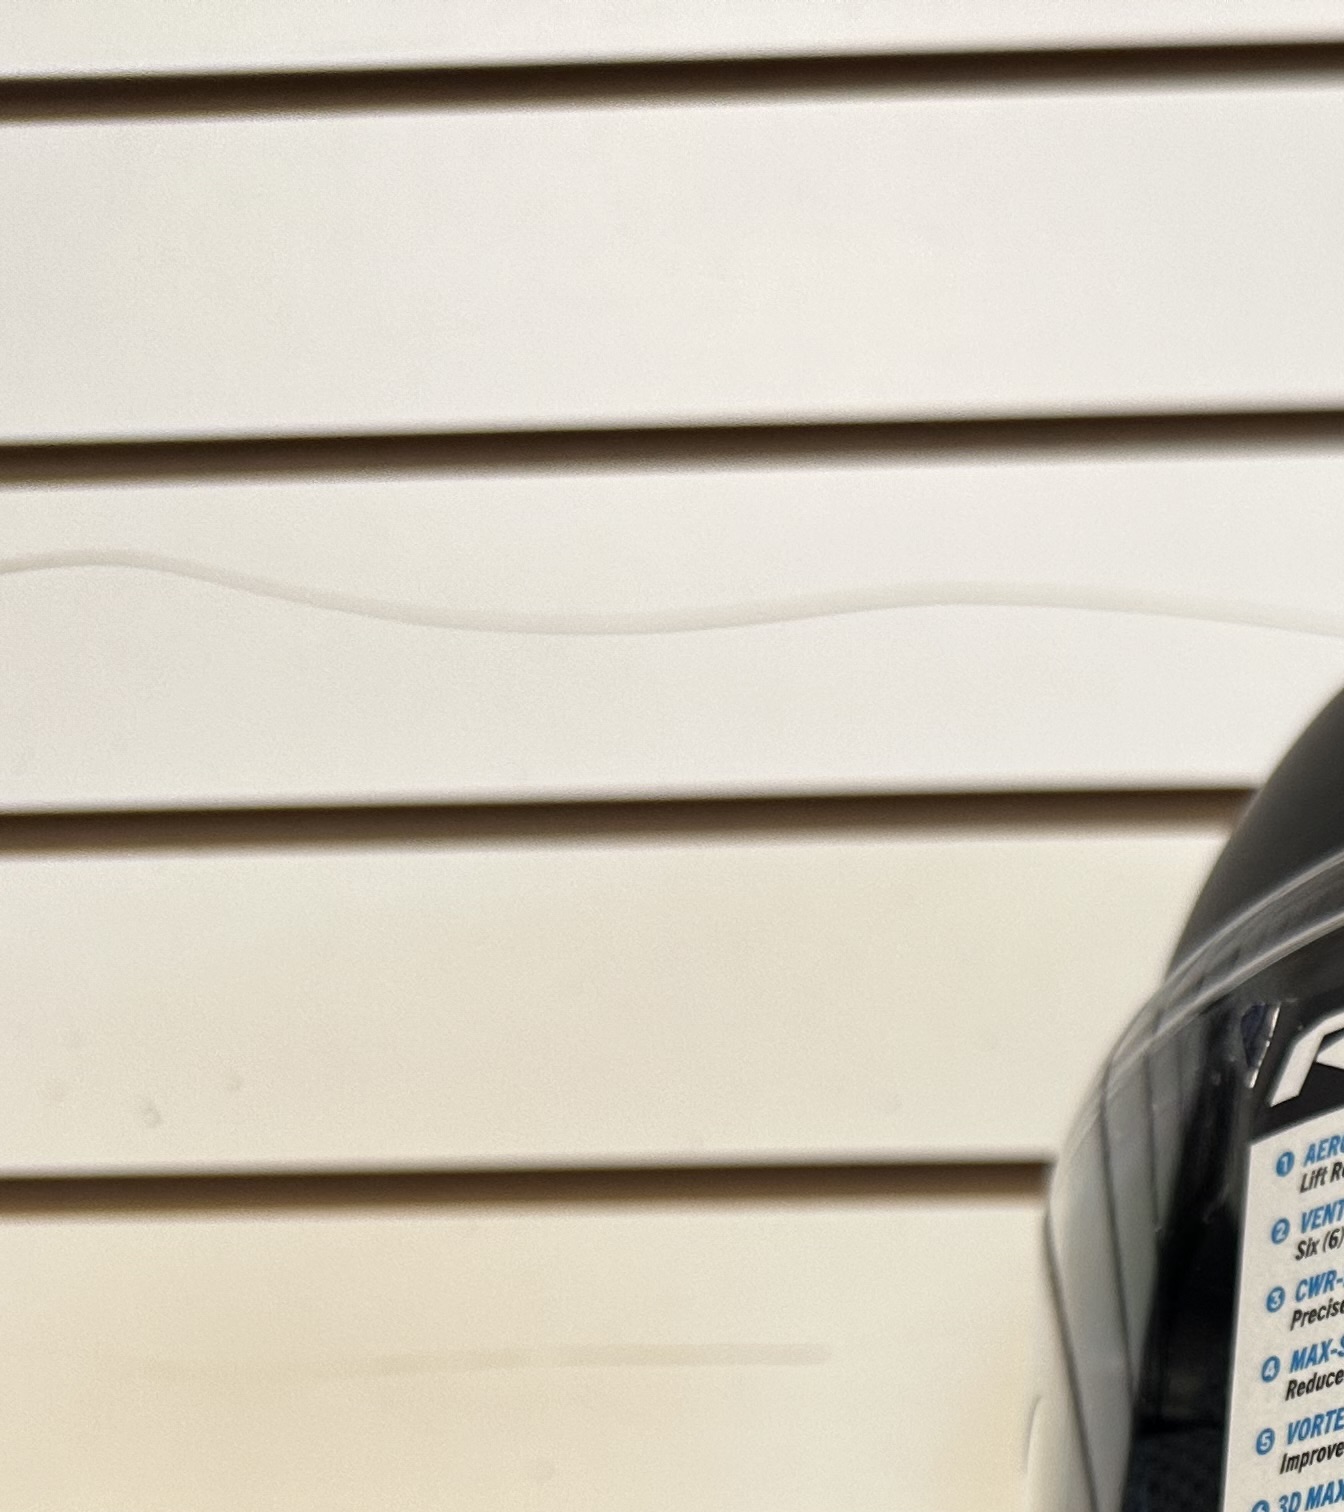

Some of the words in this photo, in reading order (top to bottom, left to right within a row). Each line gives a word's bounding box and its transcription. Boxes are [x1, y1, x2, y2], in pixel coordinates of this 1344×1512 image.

[1299, 1167, 1326, 1194] Lift
[1296, 1232, 1318, 1262] Six
[1322, 1226, 1344, 1252] (6)
[1279, 1435, 1344, 1475] Improve
